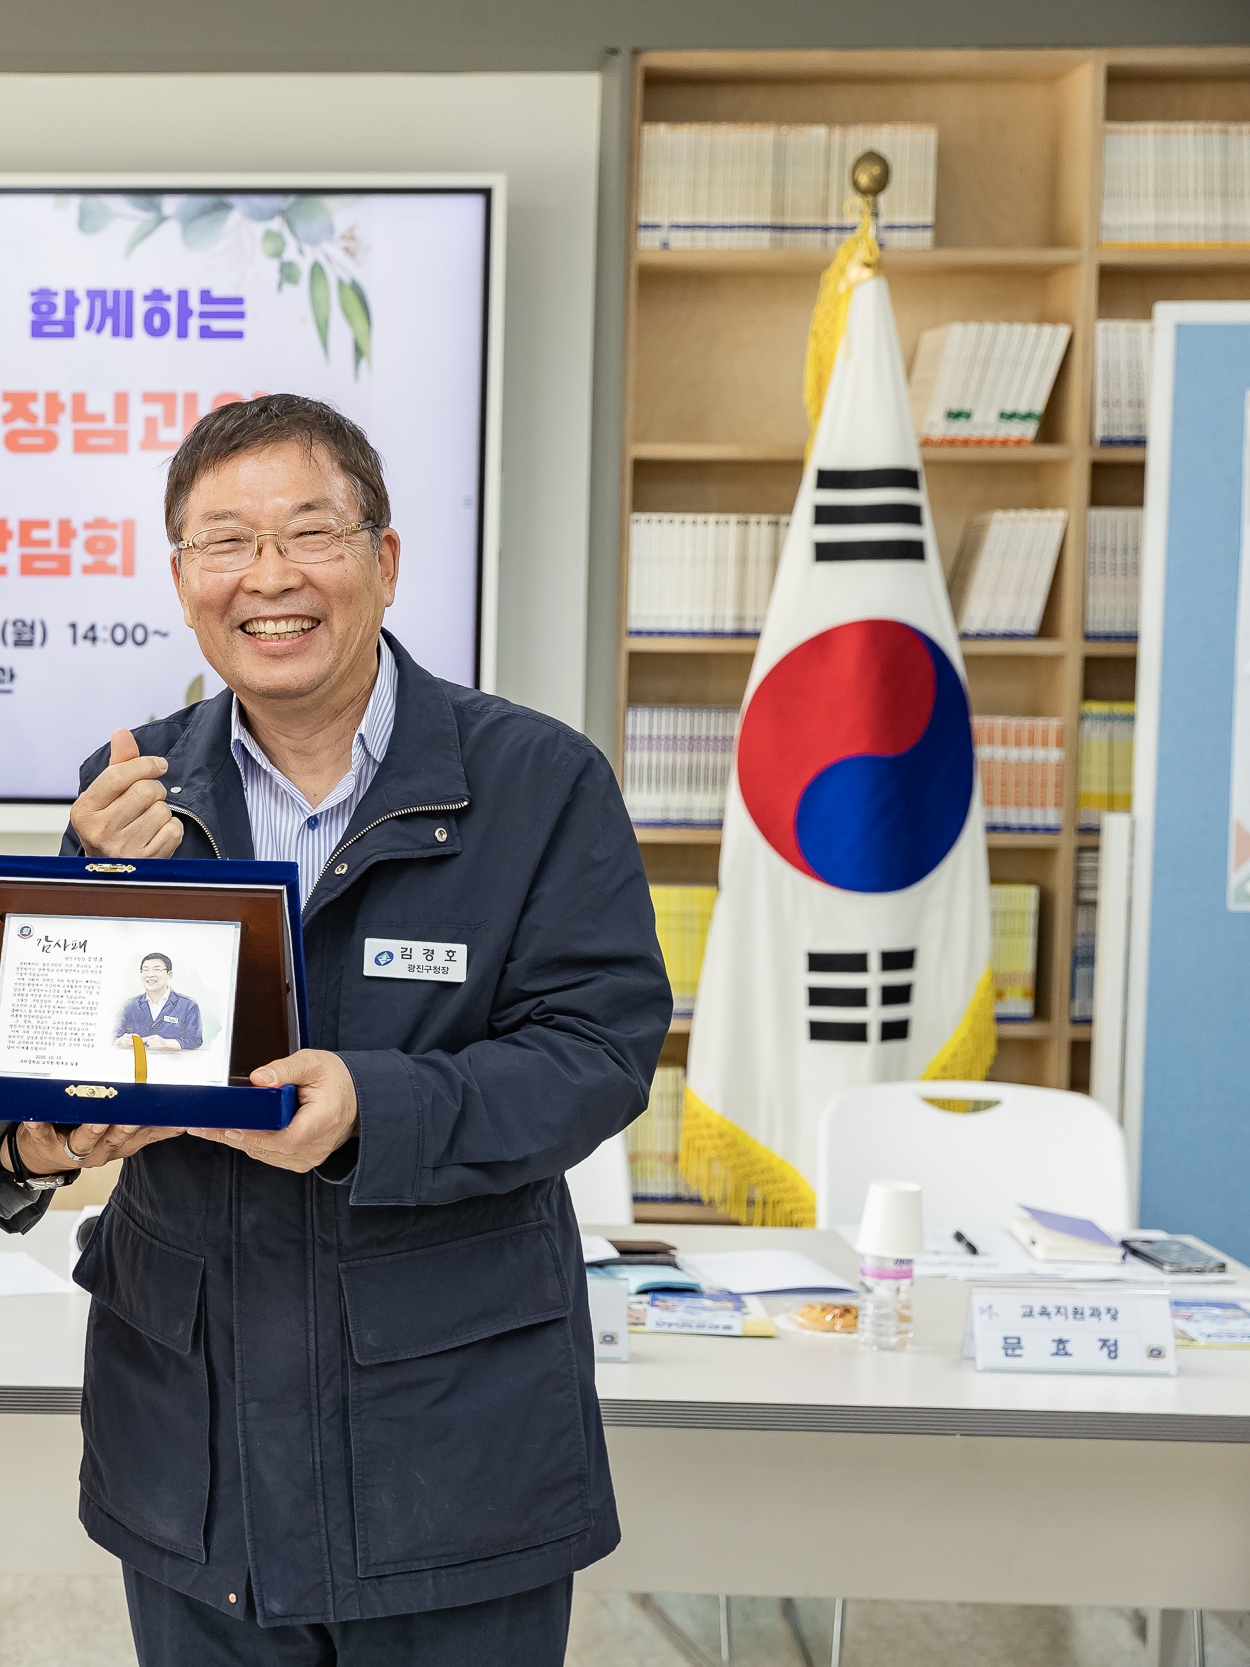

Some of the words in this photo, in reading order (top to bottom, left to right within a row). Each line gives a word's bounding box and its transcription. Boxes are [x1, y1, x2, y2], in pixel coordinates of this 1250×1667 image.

[30, 288, 245, 339] 함께하는
[67, 621, 170, 646] 14:00~
[36, 935, 88, 953] 감사패
[407, 963, 449, 975] 광진구청장
[1020, 1304, 1120, 1321] 교육지원과장
